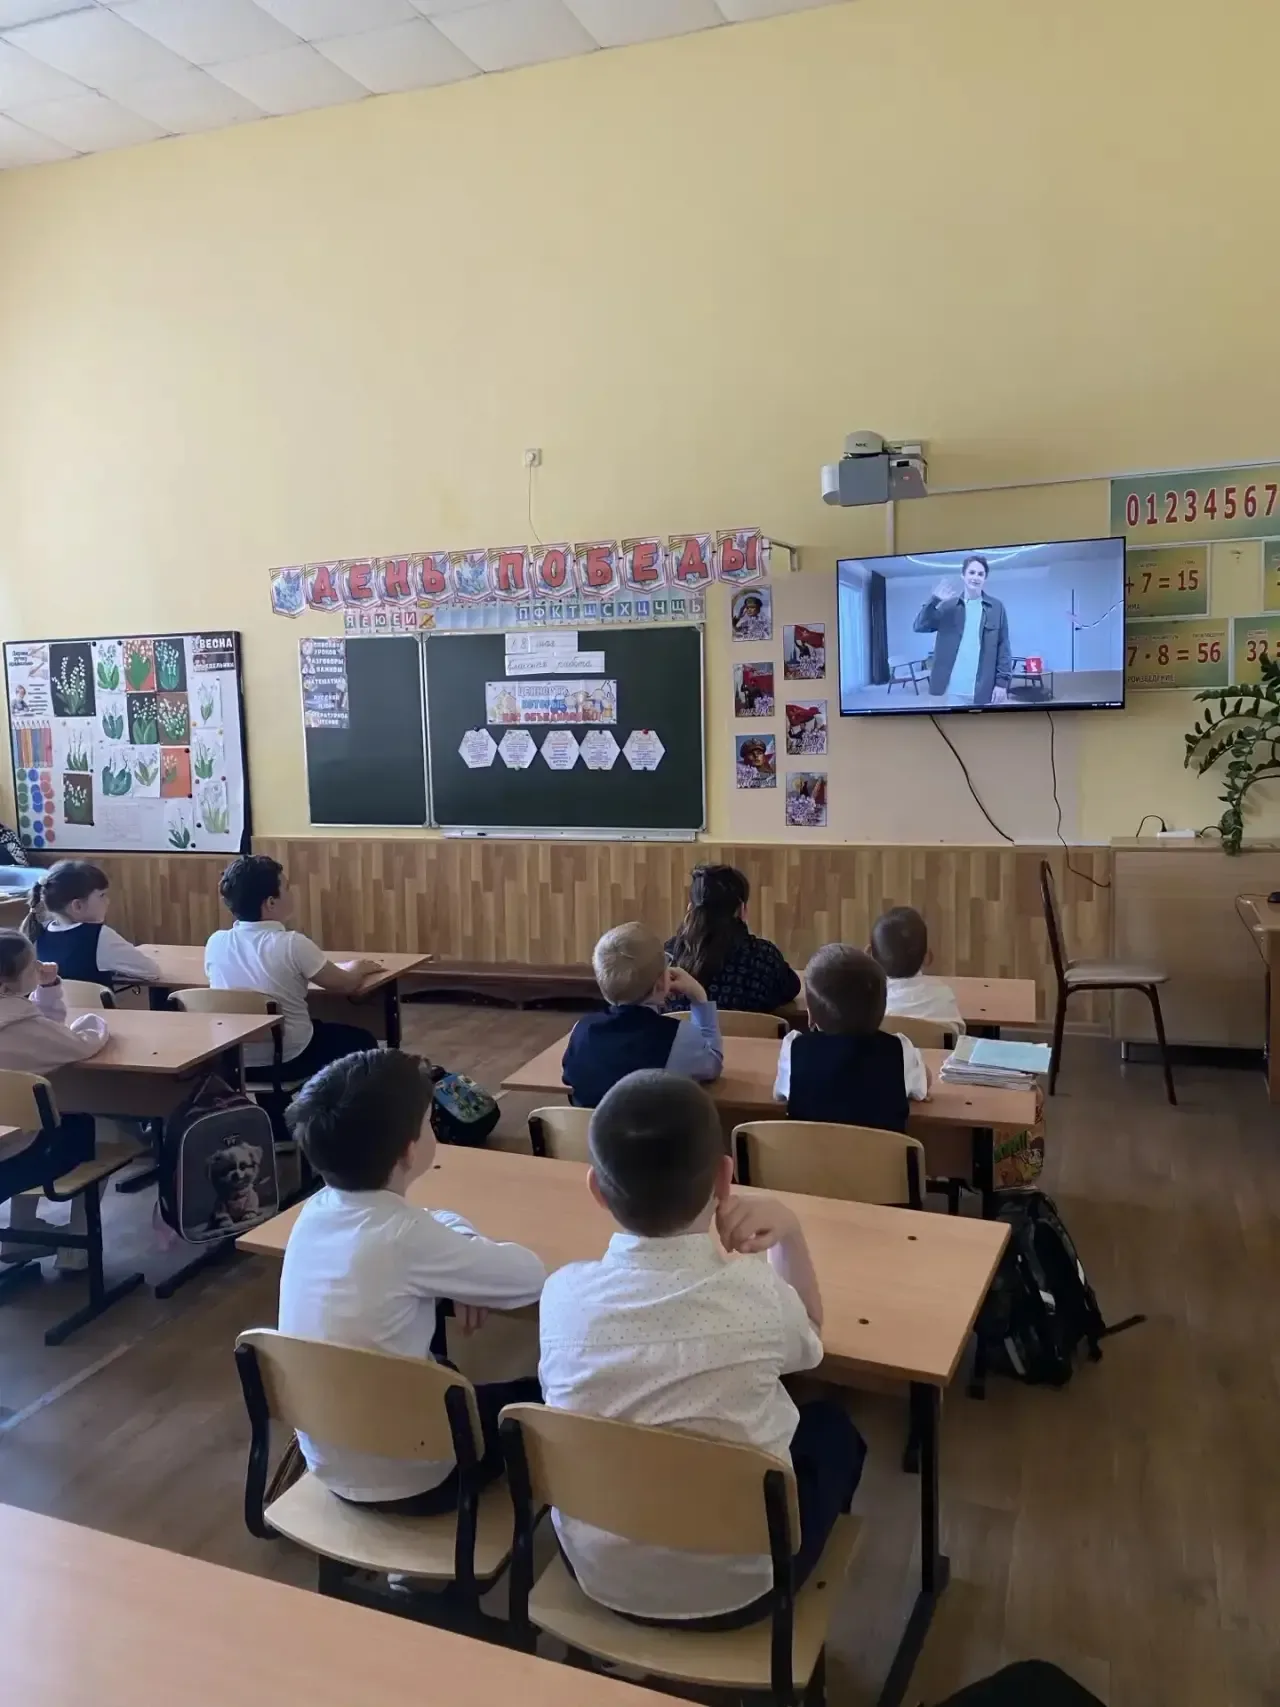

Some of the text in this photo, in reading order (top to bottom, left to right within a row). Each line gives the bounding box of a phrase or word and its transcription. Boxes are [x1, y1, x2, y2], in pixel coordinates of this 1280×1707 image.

[313, 536, 758, 604] ДЕНЬ ПОБЕДЫ
[1178, 570, 1198, 591] 15
[199, 638, 232, 649] ВЕСНА
[1197, 642, 1221, 663] 56
